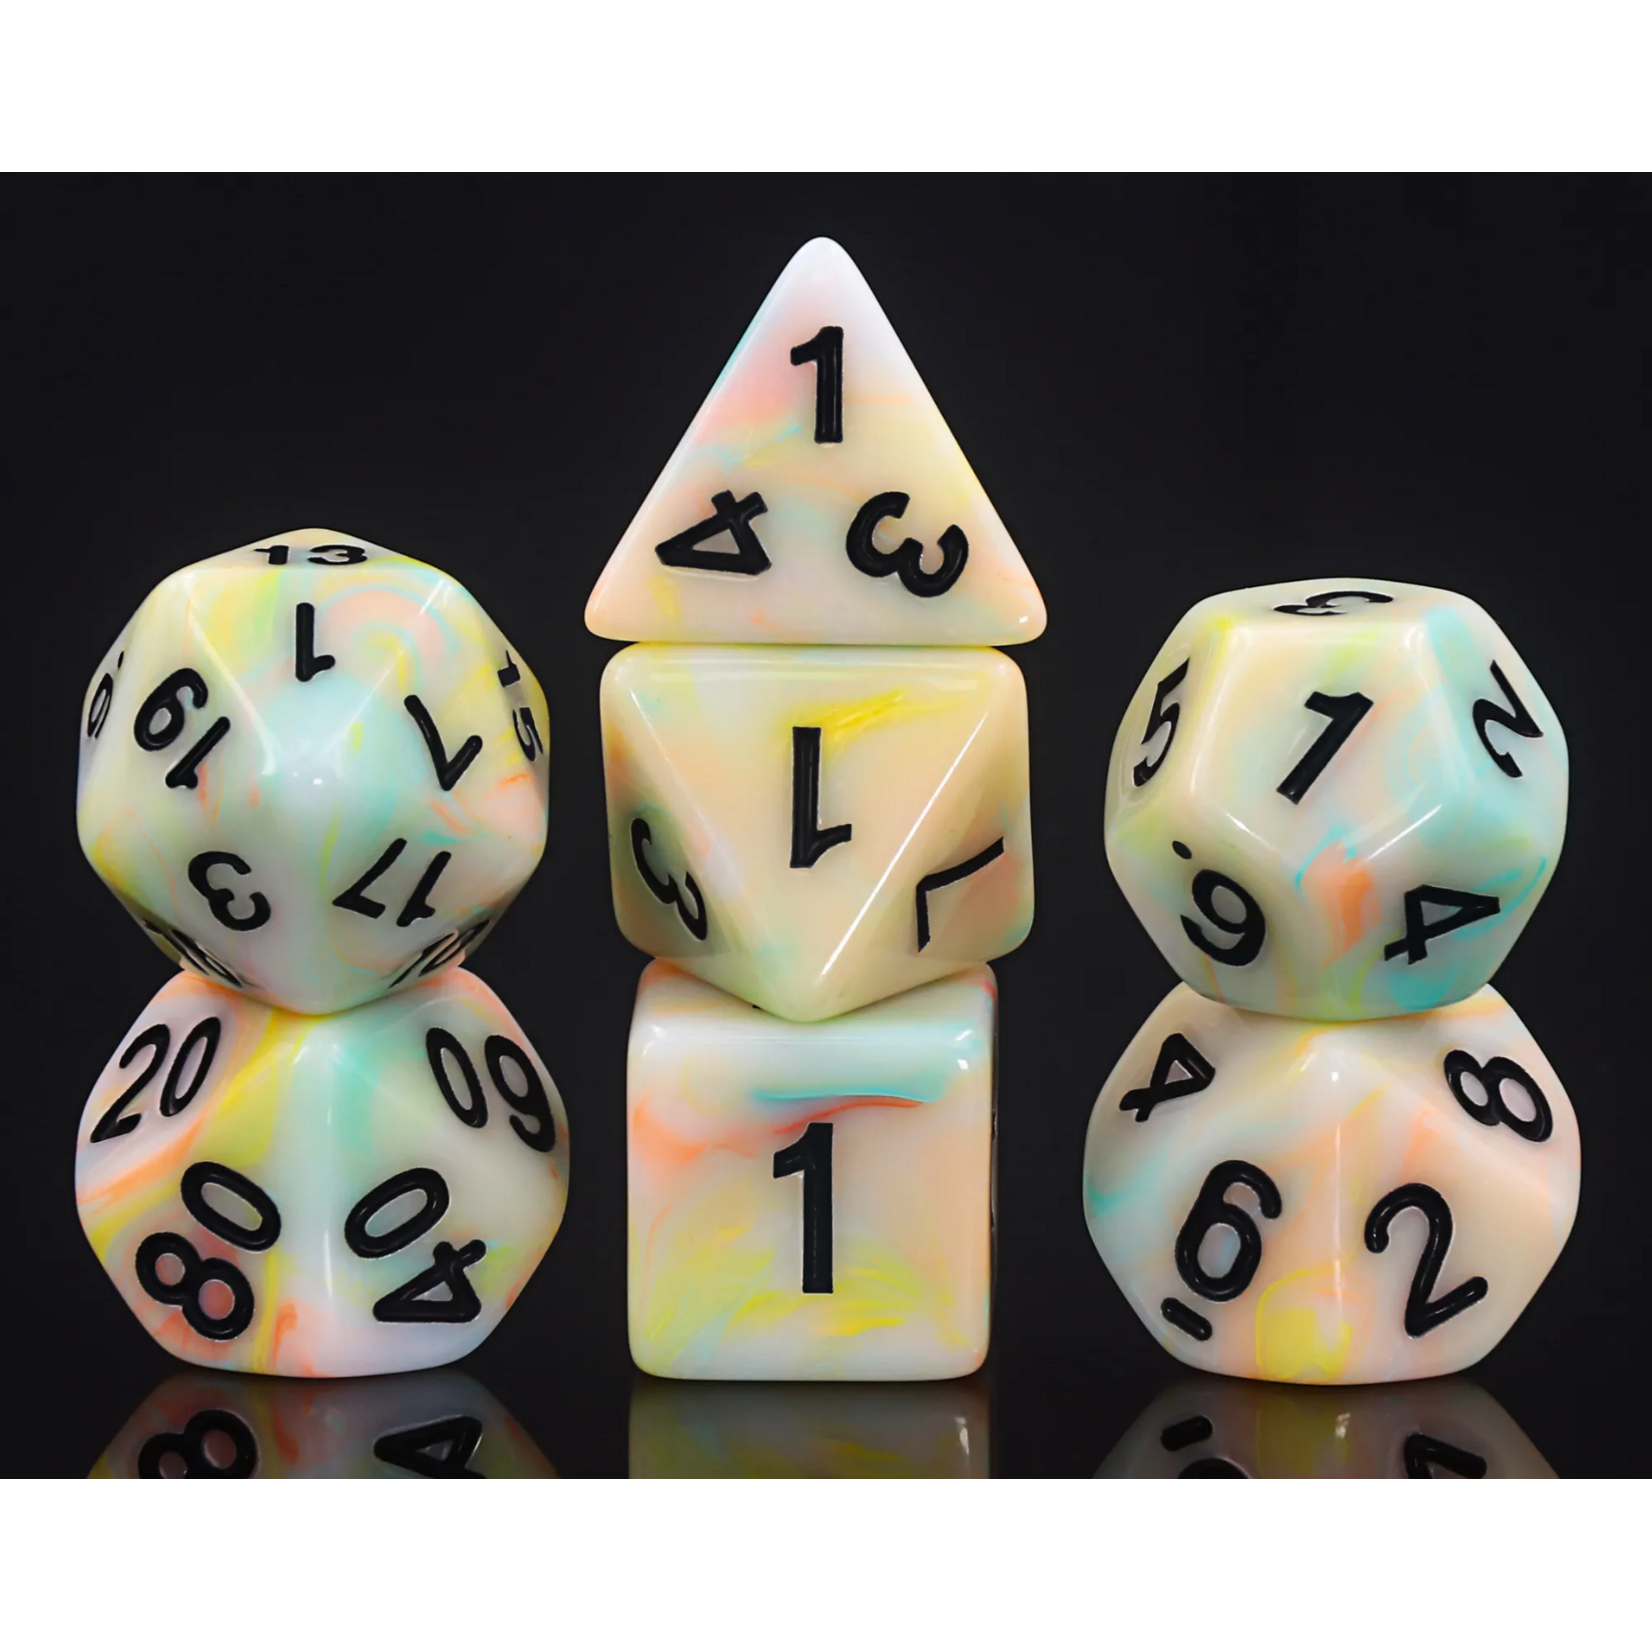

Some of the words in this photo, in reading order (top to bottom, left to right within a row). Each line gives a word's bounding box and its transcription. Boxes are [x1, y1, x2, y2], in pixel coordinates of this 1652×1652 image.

[790, 325, 844, 445] 1
[253, 543, 369, 566] 13
[654, 489, 772, 576] 4
[845, 491, 969, 598] 3
[295, 602, 336, 683] 1
[1272, 590, 1394, 617] 3
[403, 694, 483, 792] 7
[1132, 656, 1191, 788] 5
[1276, 691, 1374, 805] 1
[1472, 659, 1544, 778] 2
[789, 726, 853, 869] 1
[187, 850, 272, 932] 3
[331, 837, 452, 928] 17
[630, 817, 708, 941] 3
[1383, 883, 1501, 966] 4
[89, 1016, 222, 1144] 20
[1118, 1032, 1216, 1123] 4
[1443, 1049, 1553, 1143] 8
[134, 1160, 282, 1341] 80
[343, 1167, 487, 1324] 40
[772, 1121, 834, 1294] 1
[1363, 1182, 1489, 1338] 2
